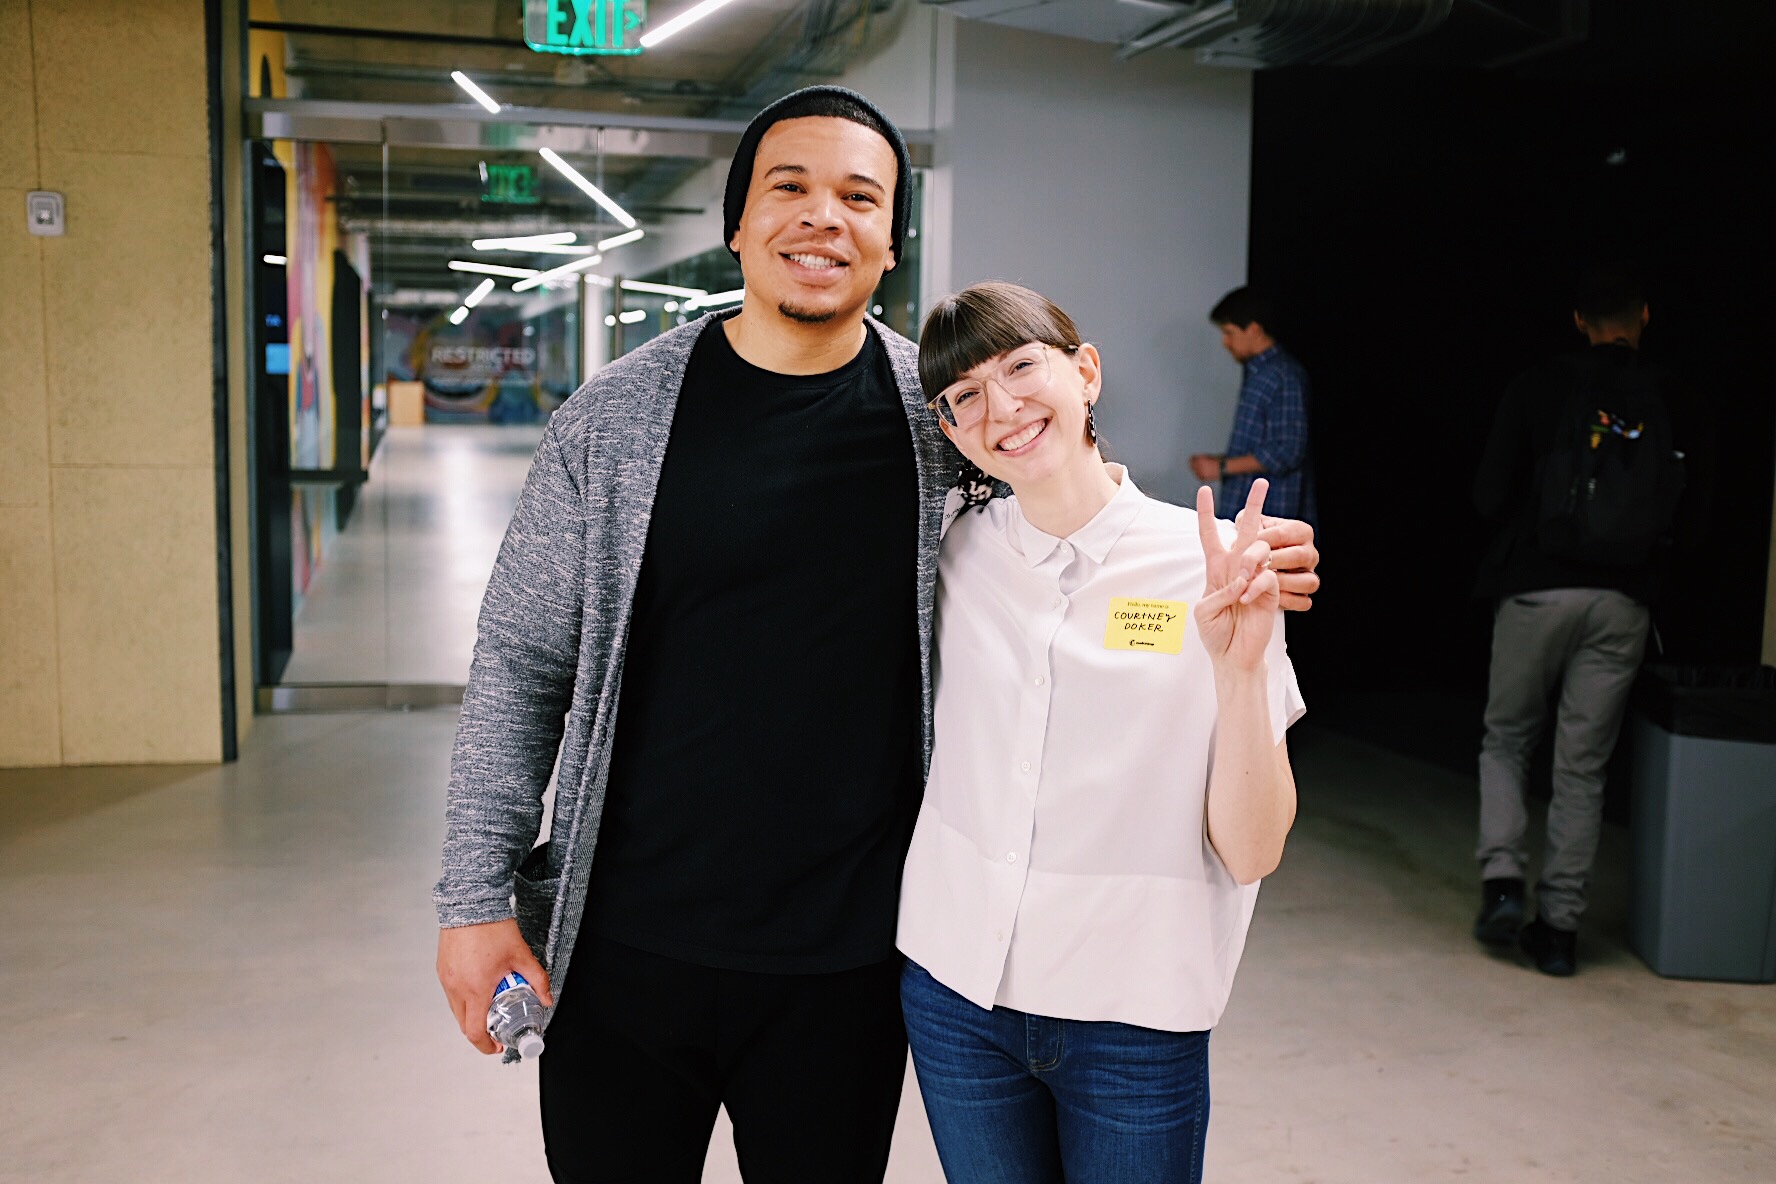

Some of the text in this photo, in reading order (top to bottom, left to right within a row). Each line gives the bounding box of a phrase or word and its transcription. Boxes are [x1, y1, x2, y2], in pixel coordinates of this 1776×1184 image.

[546, 0, 631, 47] EXIT
[431, 346, 536, 365] RESTRICTED
[1114, 611, 1176, 622] COURTNEY
[1124, 622, 1163, 632] DOKER
